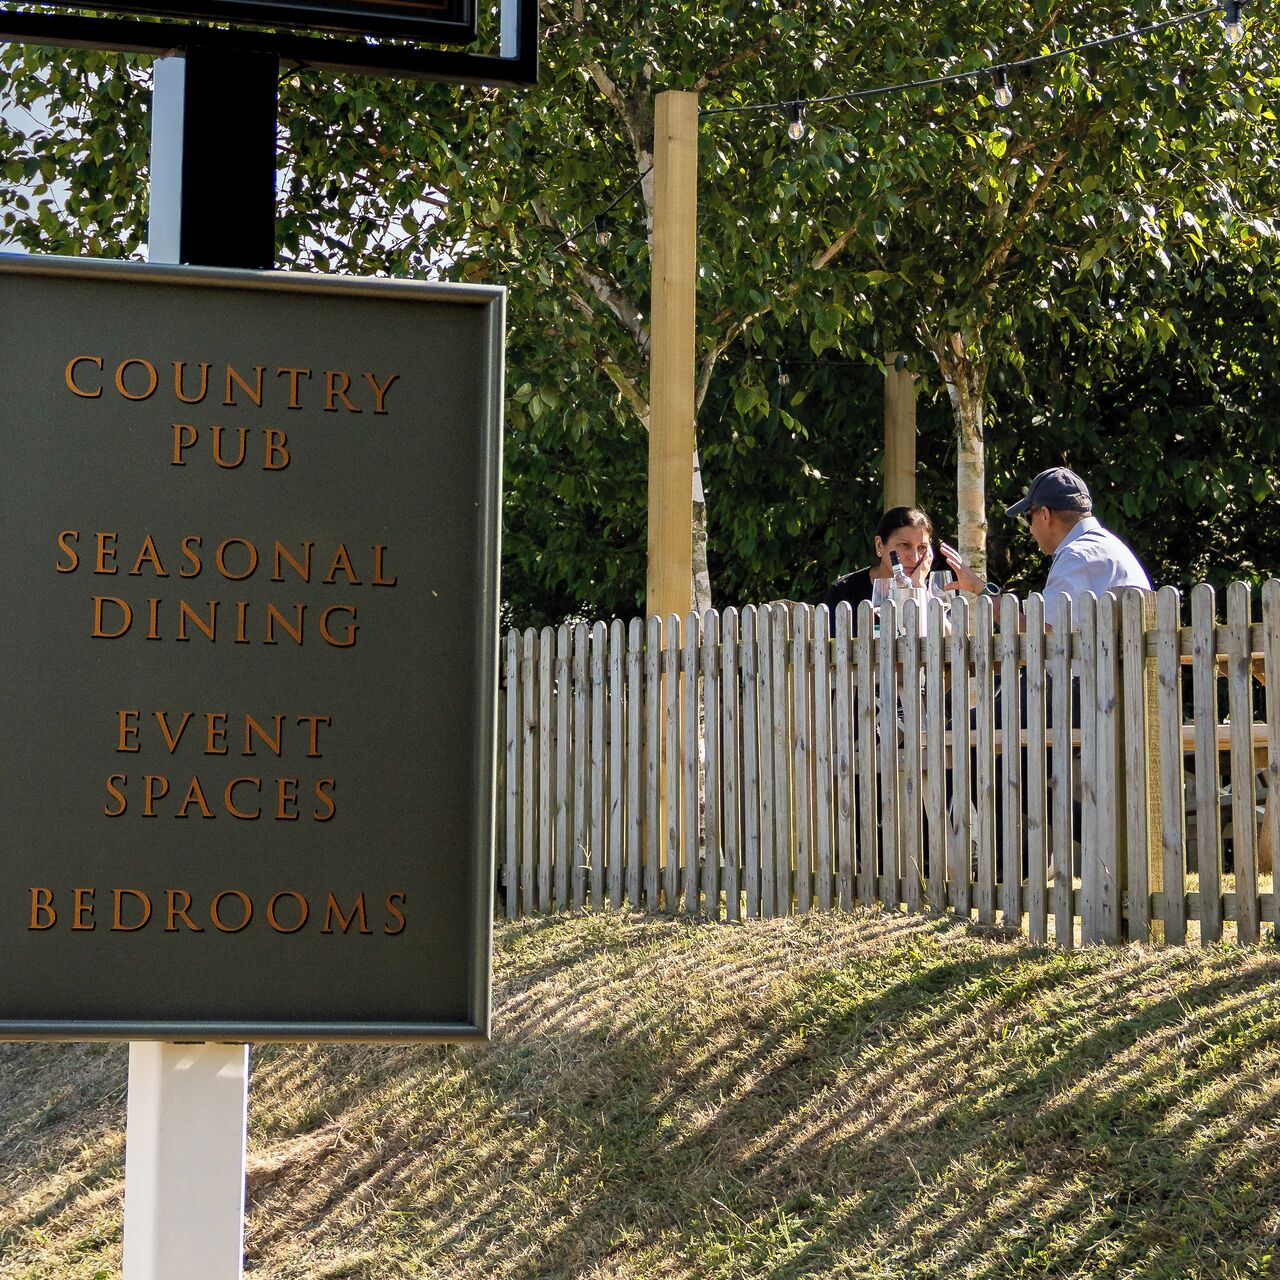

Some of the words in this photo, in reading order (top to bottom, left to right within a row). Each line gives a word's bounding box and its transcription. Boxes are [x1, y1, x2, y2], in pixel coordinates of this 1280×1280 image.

[64, 355, 400, 413] COUNTRY
[170, 423, 291, 470] PUB
[55, 529, 398, 585] SEASONAL
[90, 596, 360, 646] DINING
[115, 709, 332, 756] EVENT
[103, 773, 337, 821] SPACES
[28, 886, 408, 934] BEDROOMS
